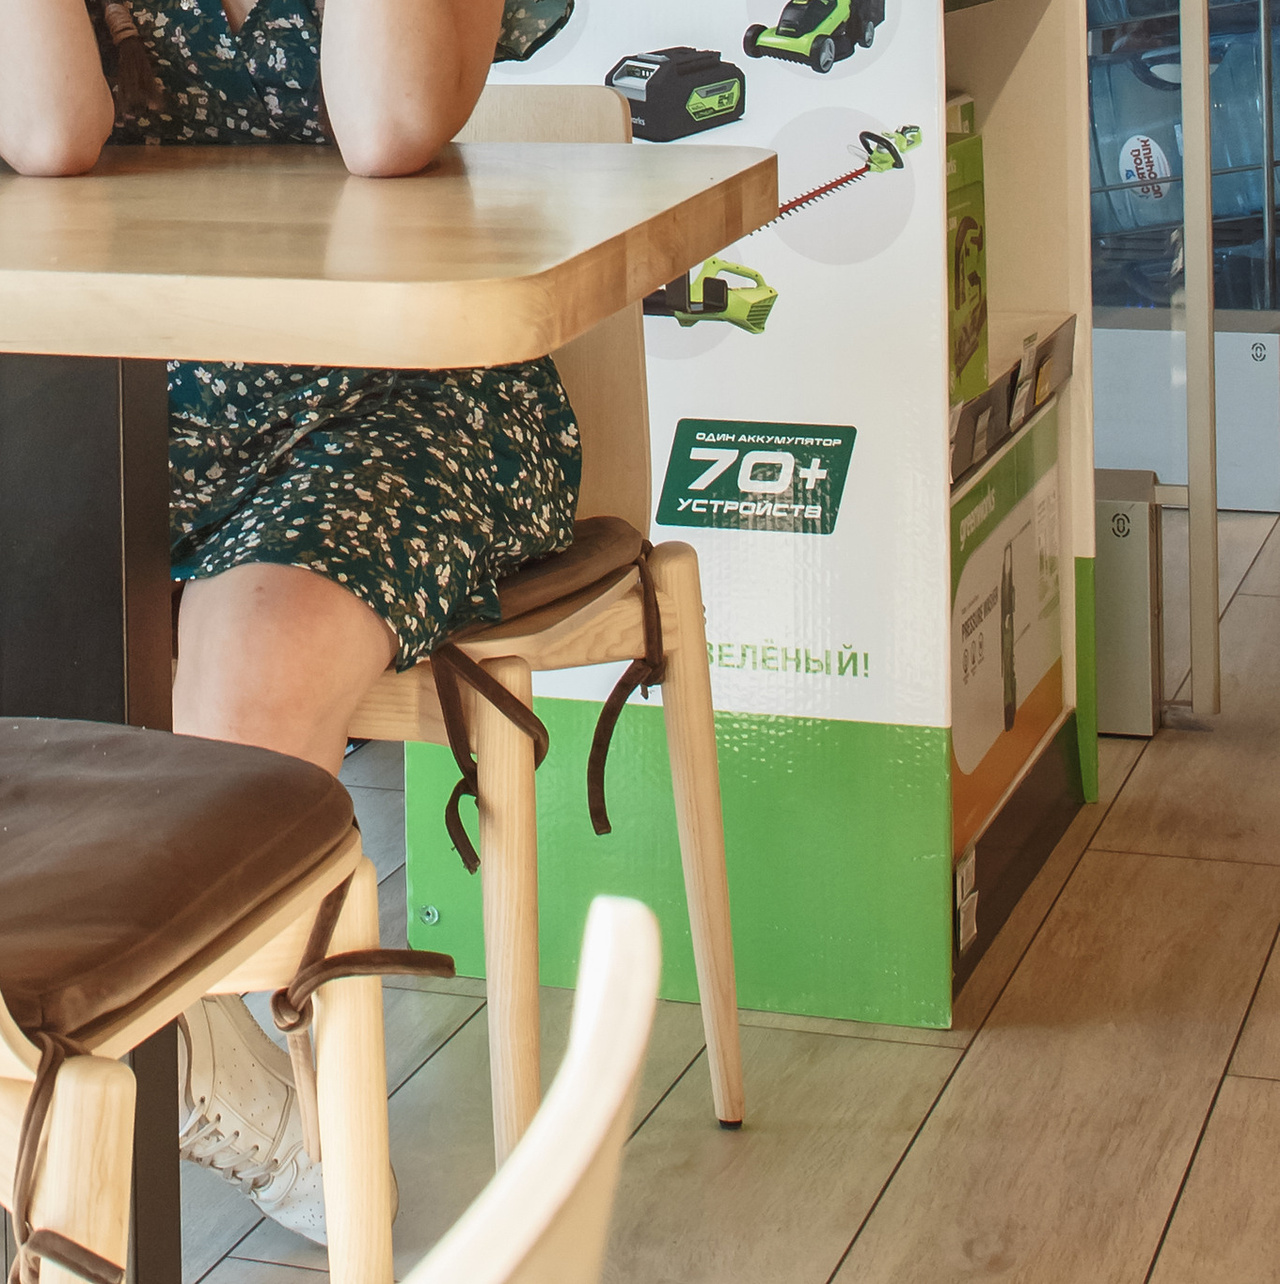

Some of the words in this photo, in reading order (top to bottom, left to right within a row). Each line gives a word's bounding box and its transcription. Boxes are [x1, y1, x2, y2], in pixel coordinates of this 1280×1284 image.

[1130, 148, 1151, 194] СЯТОЙ
[1140, 139, 1163, 199] ИСОЧНИК
[695, 431, 736, 443] ОДИН
[737, 433, 842, 447] АККУМУЛЯТОР
[687, 447, 828, 494] 70+
[676, 498, 823, 519] УСТРОЙСТВ
